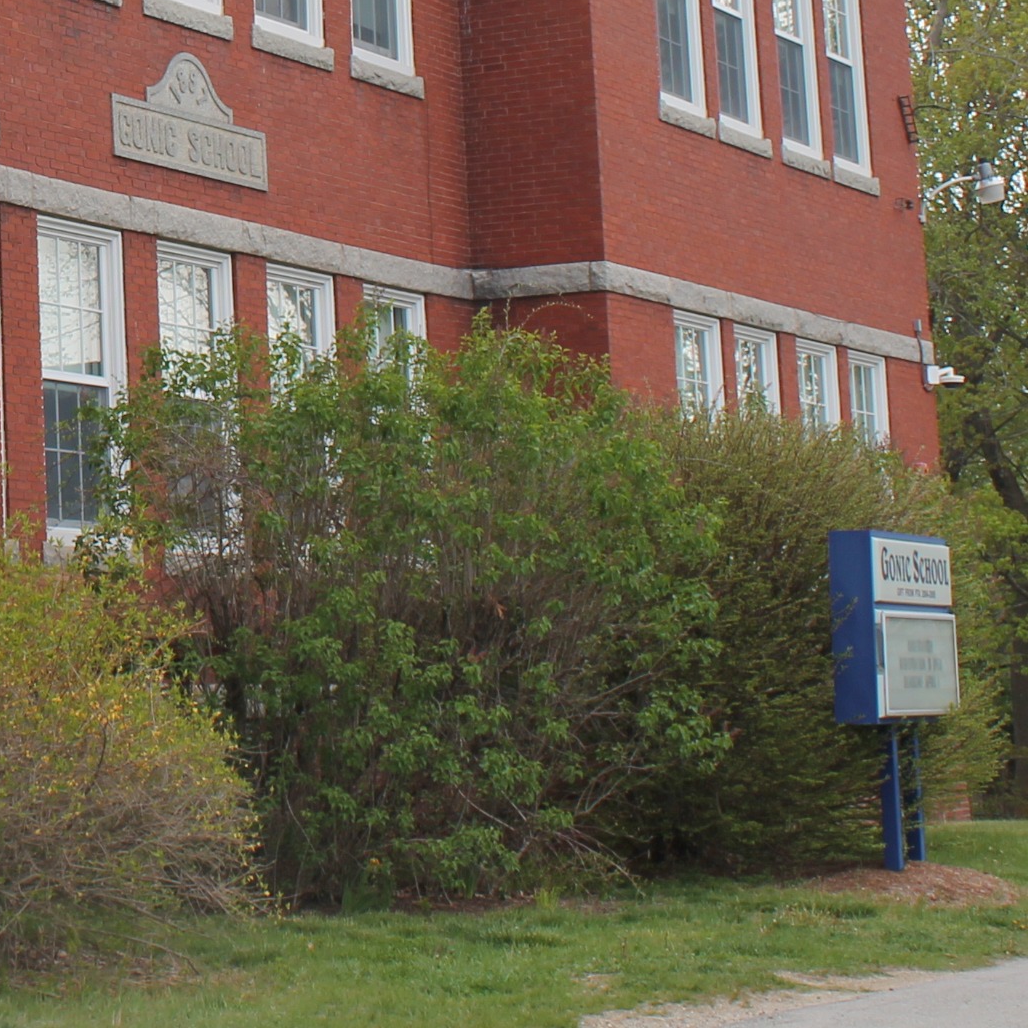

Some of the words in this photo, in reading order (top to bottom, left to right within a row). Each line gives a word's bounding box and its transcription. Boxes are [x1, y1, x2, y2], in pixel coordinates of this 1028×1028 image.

[118, 109, 177, 157] GONIC
[187, 125, 262, 178] SCHOOL
[881, 546, 911, 583] GONIC
[913, 550, 949, 585] SCHOOL
